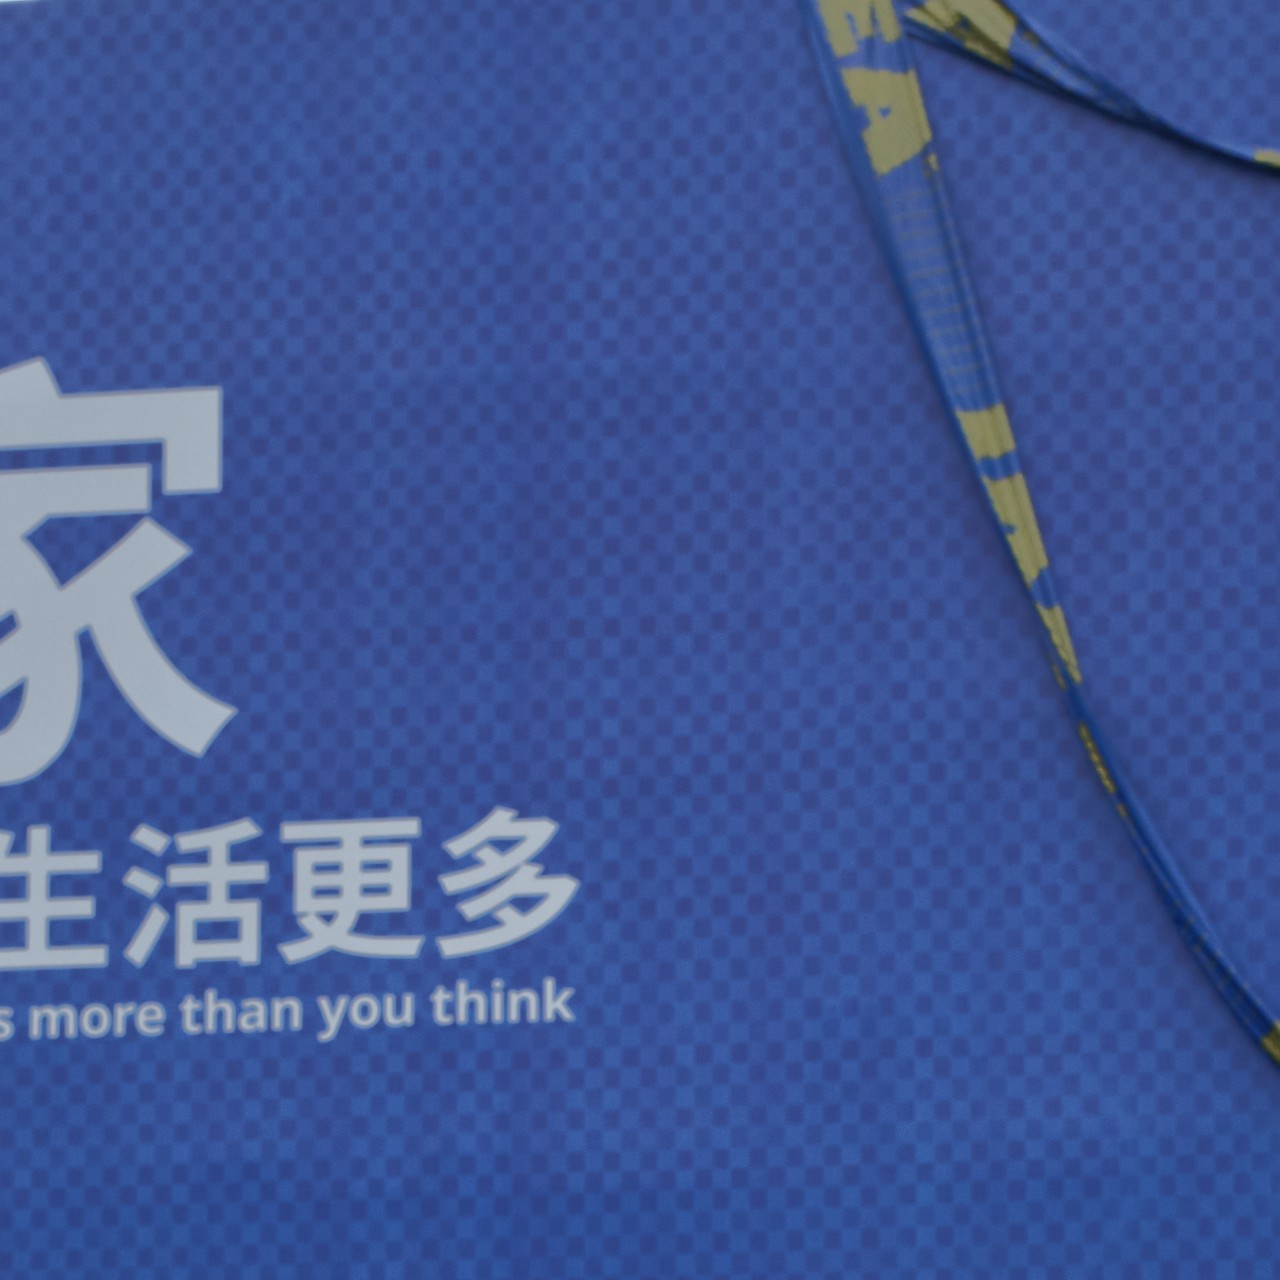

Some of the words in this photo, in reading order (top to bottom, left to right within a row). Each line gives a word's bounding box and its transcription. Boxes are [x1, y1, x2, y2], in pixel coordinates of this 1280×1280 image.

[28, 999, 167, 1039] more
[179, 988, 303, 1035] than
[317, 991, 415, 1043] you
[430, 975, 576, 1026] think
